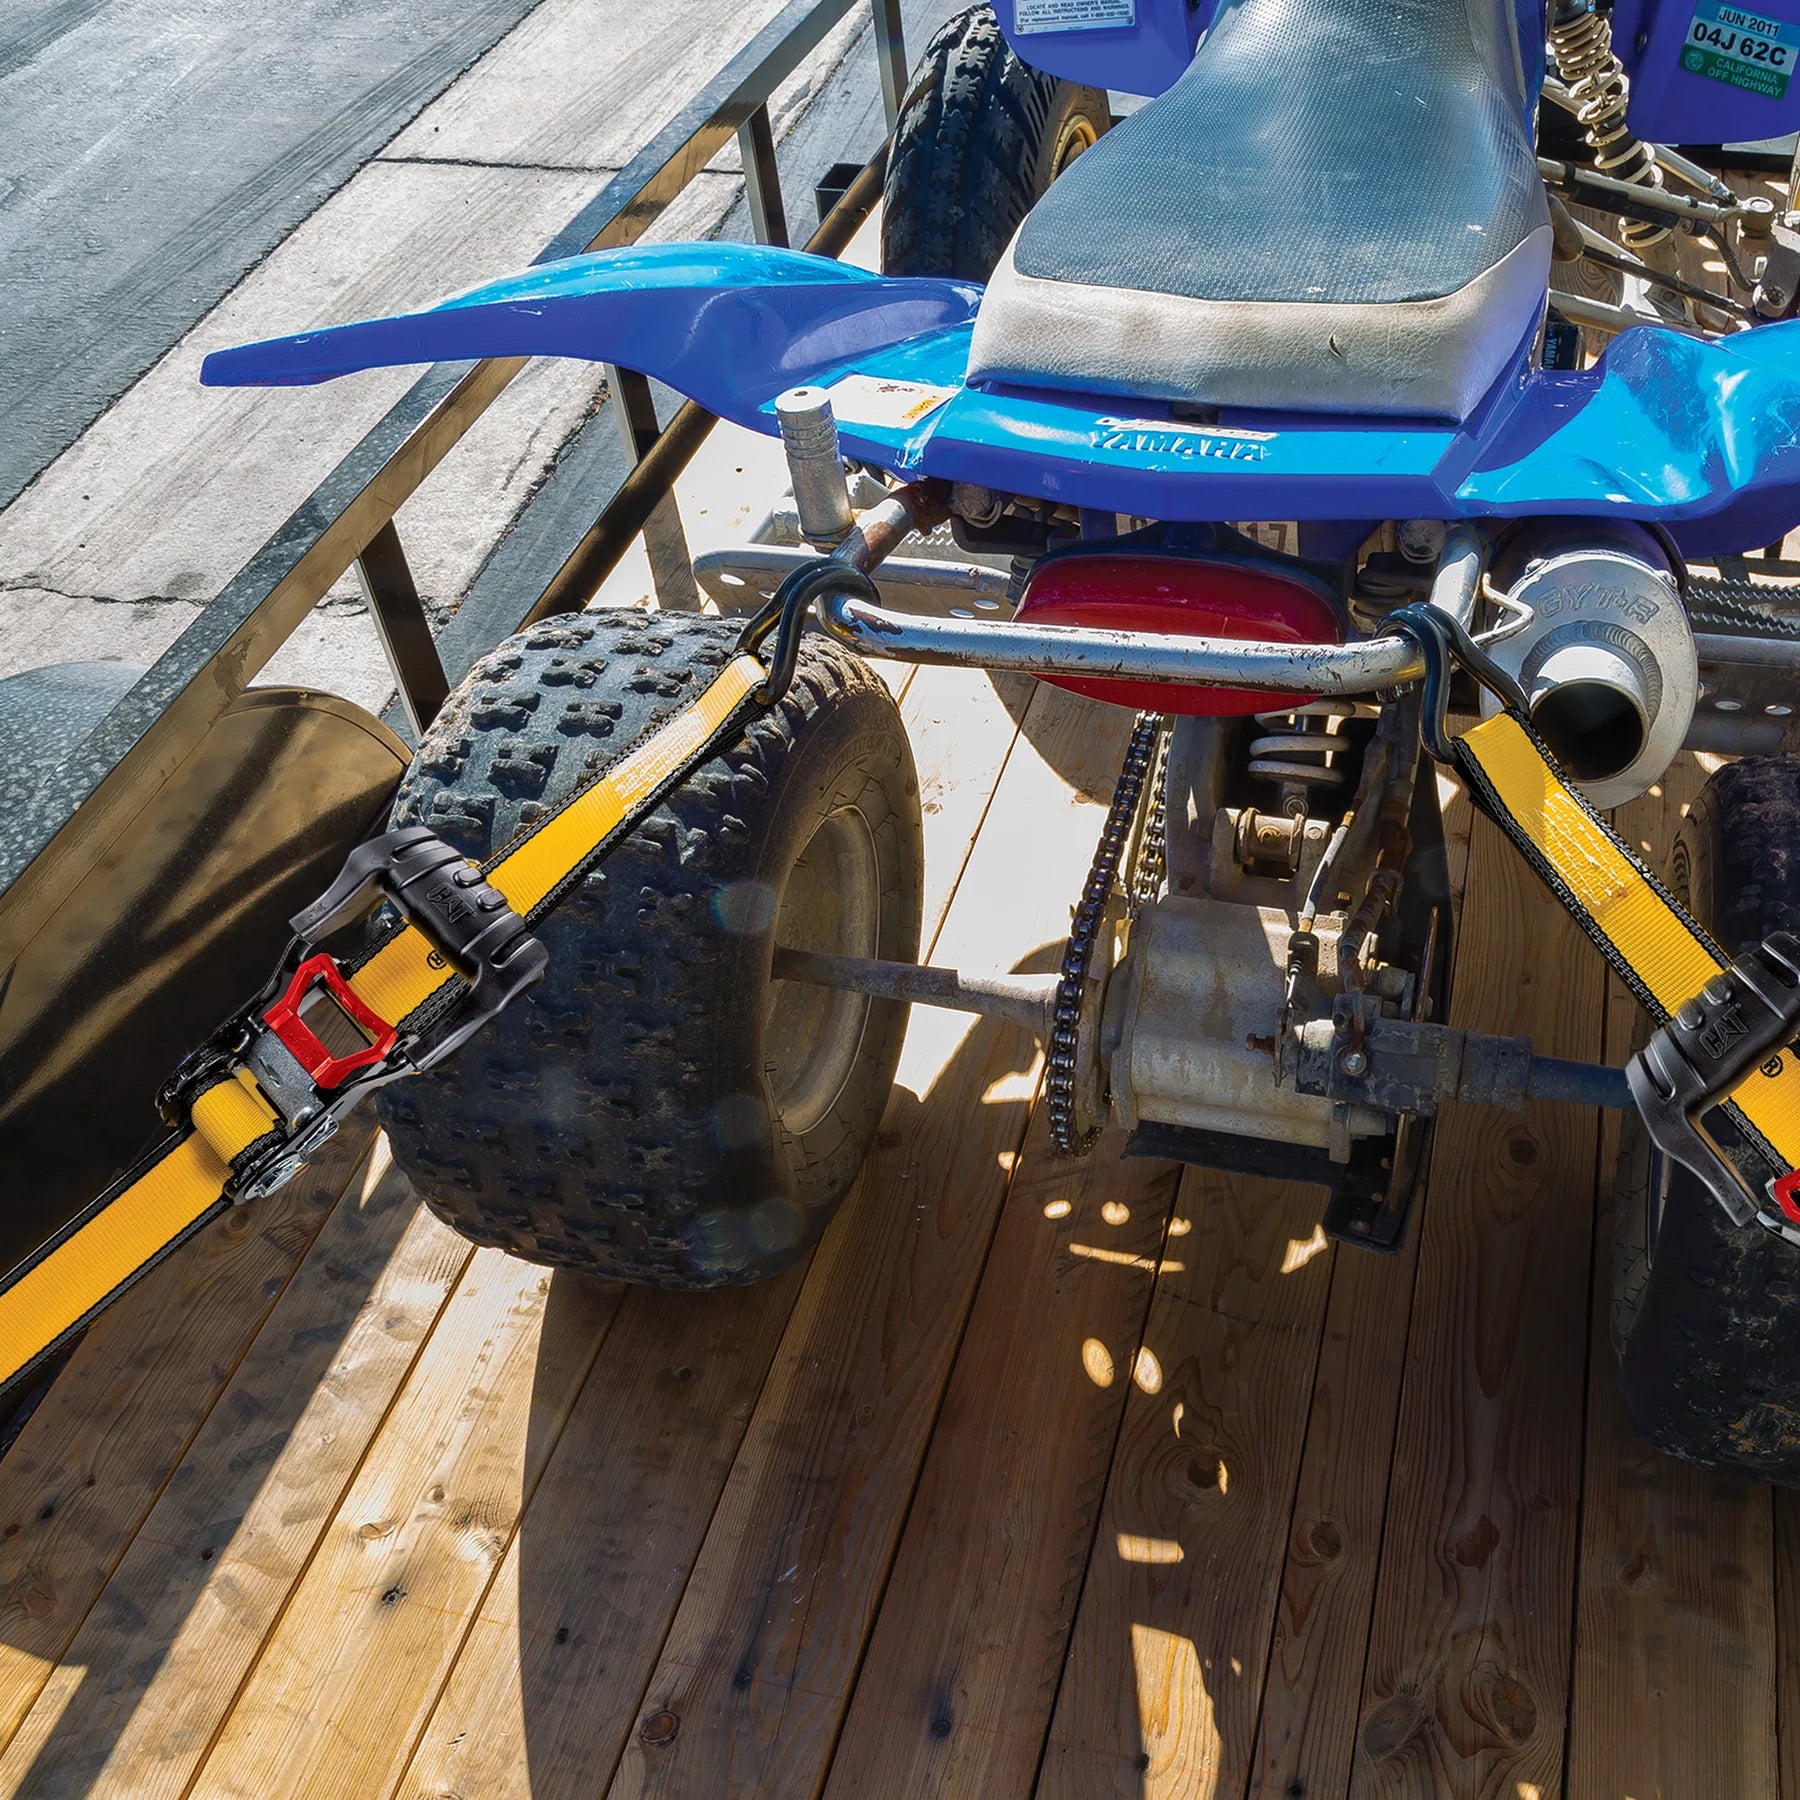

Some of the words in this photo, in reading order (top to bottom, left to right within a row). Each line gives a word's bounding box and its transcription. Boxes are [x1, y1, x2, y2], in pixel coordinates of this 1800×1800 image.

[1719, 9, 1745, 26] JUN
[1748, 17, 1779, 37] 2011
[1693, 22, 1736, 51] 04J
[1740, 37, 1787, 66] 62C
[1707, 66, 1729, 80] OFF
[1730, 74, 1782, 97] HIGHWAY
[1716, 58, 1778, 84] CALIFORNIA
[1091, 431, 1264, 462] YAMAHA
